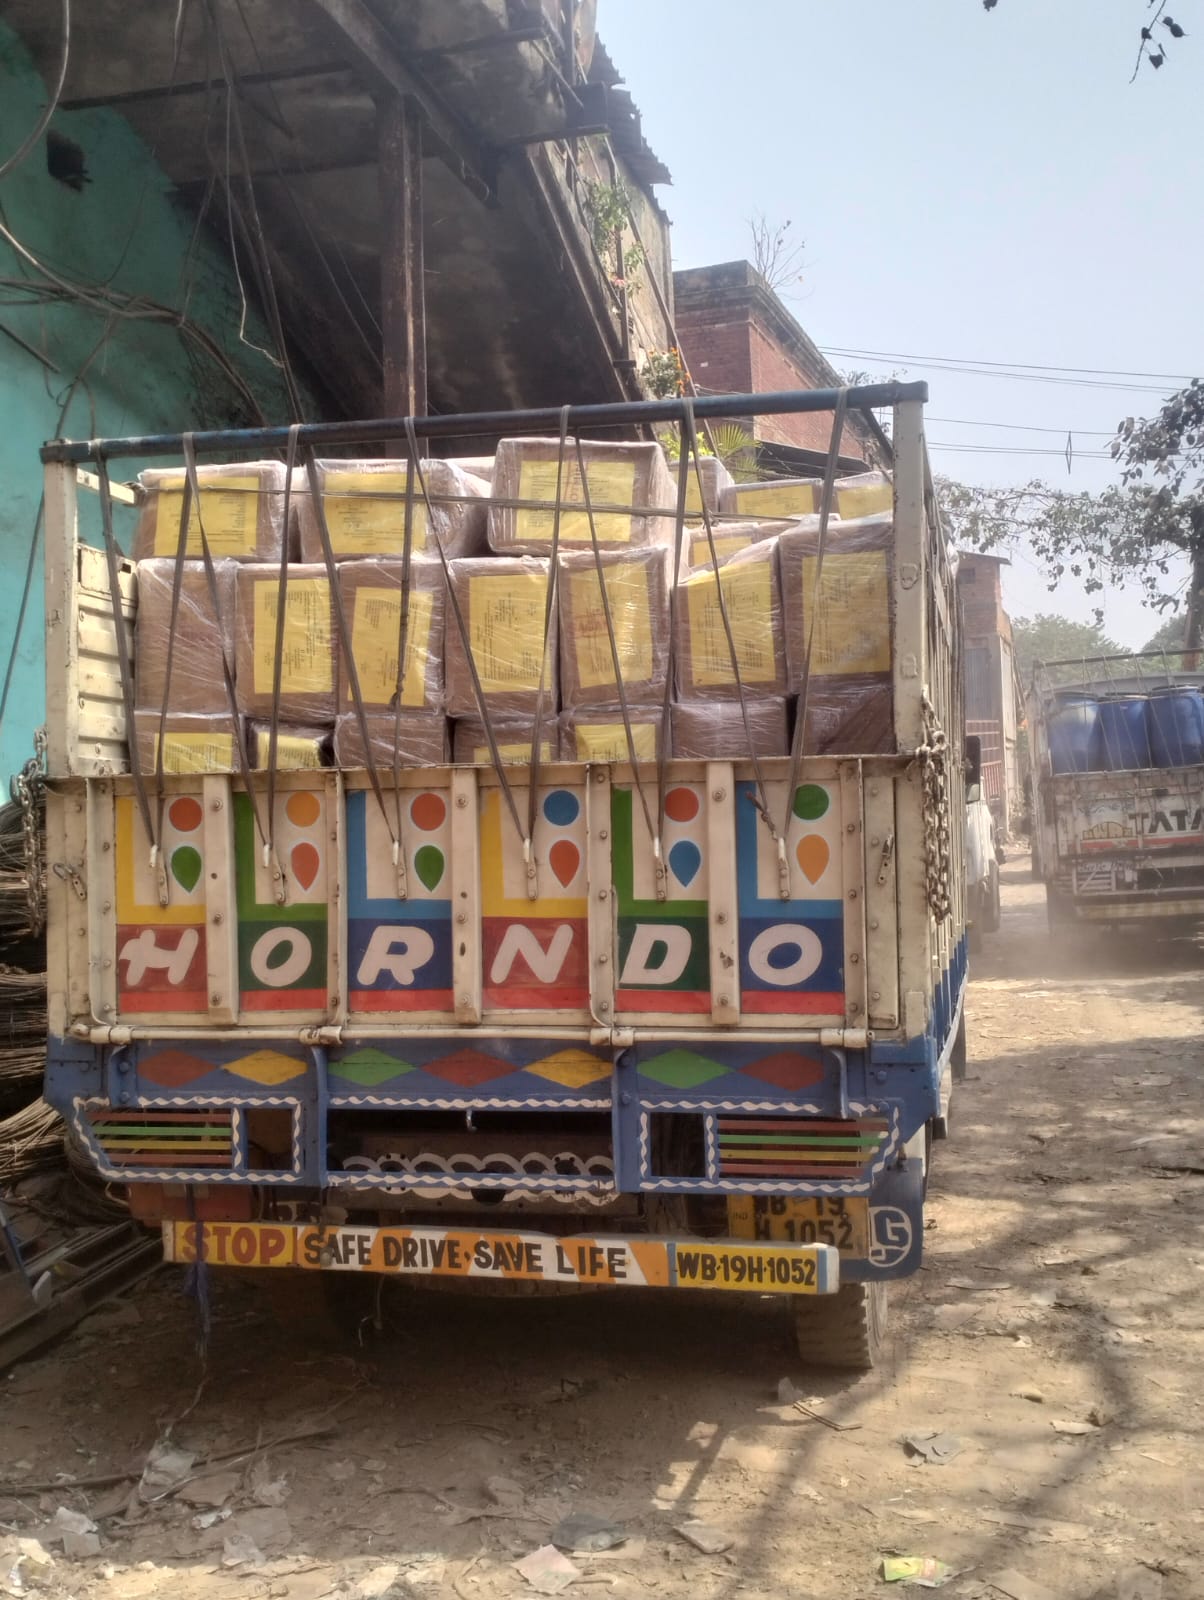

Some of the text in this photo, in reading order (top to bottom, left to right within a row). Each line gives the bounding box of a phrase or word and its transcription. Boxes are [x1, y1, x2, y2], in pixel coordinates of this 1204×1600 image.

[183, 1226, 286, 1265] STOP
[785, 1219, 854, 1249] 1052
[304, 1233, 627, 1279] SAFE DRIVE SAVE LIFE
